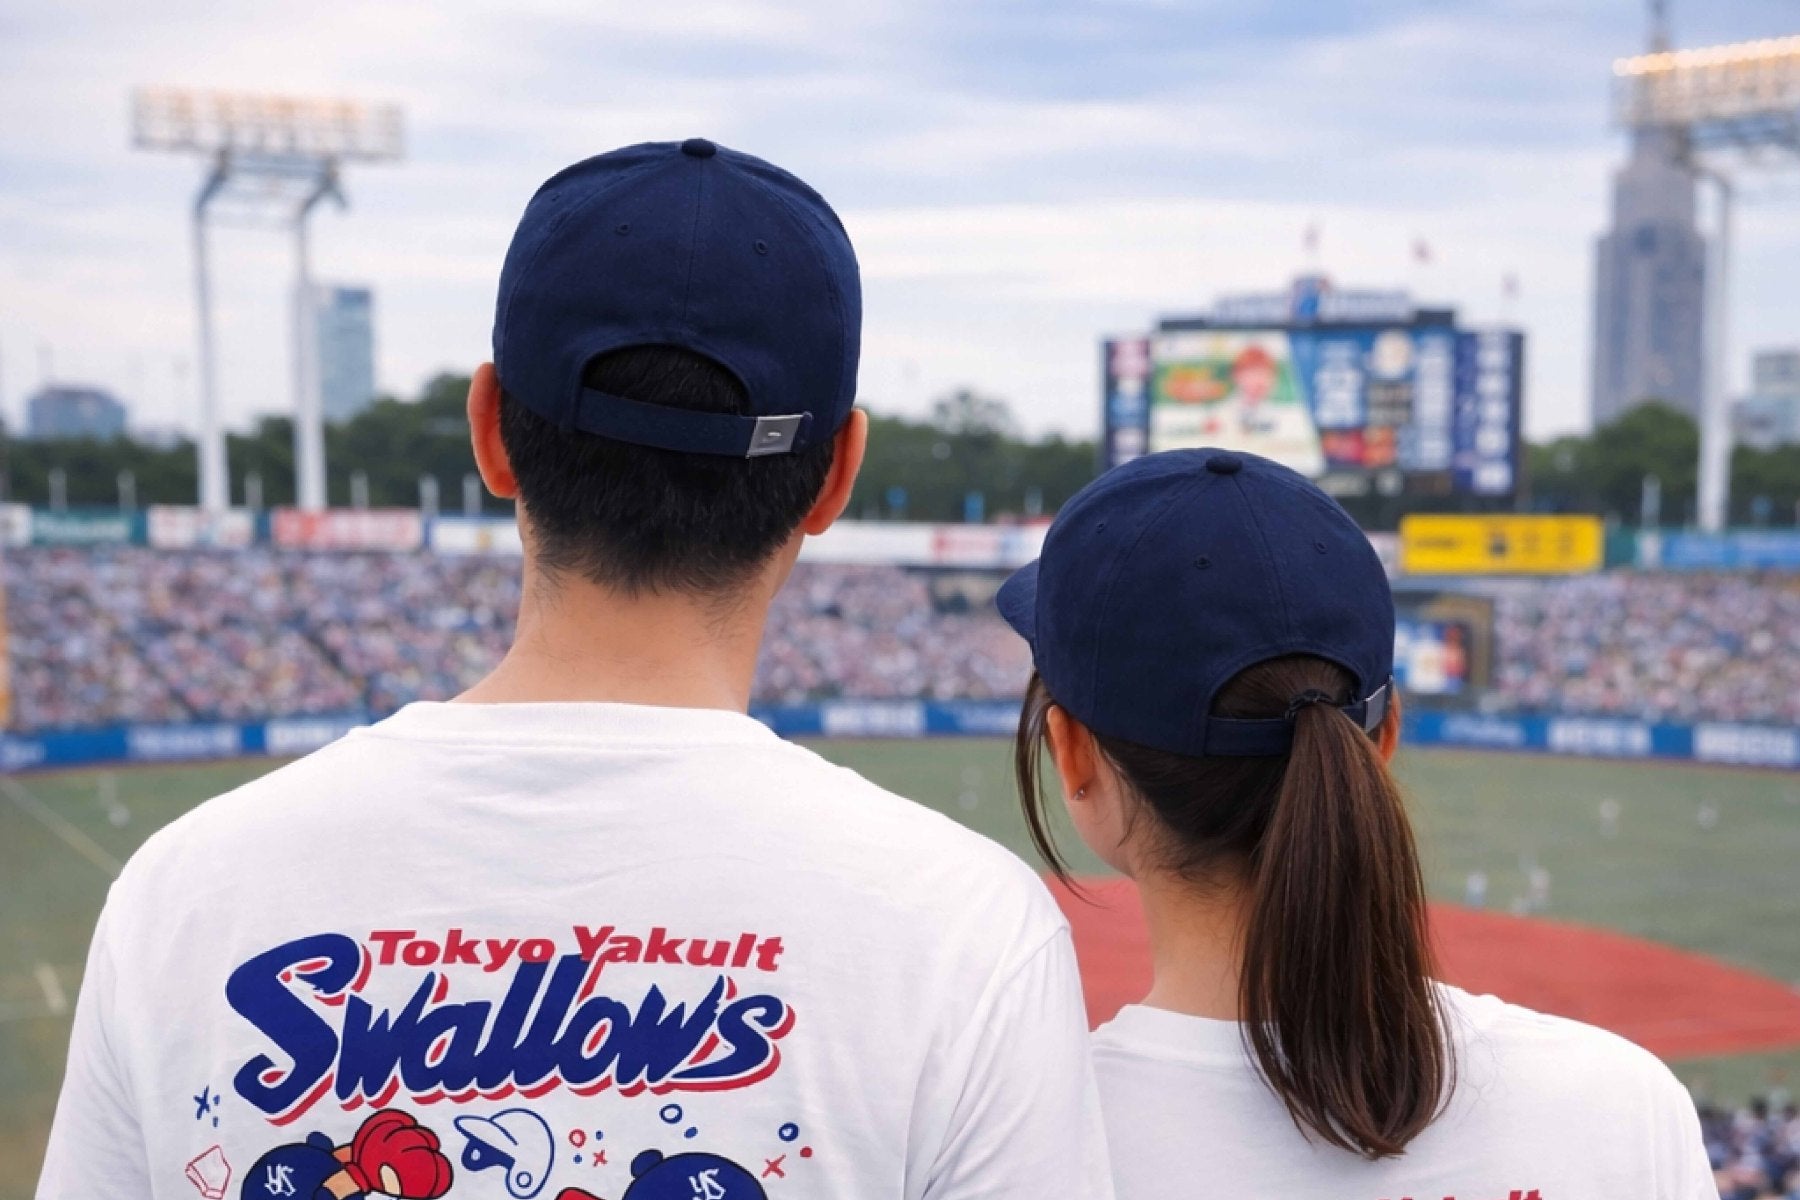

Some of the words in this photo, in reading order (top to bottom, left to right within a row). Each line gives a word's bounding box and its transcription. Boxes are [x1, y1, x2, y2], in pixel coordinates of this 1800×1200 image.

[369, 929, 555, 972] Tokyo
[573, 925, 785, 972] Yakult
[225, 932, 796, 1126] Swallows
